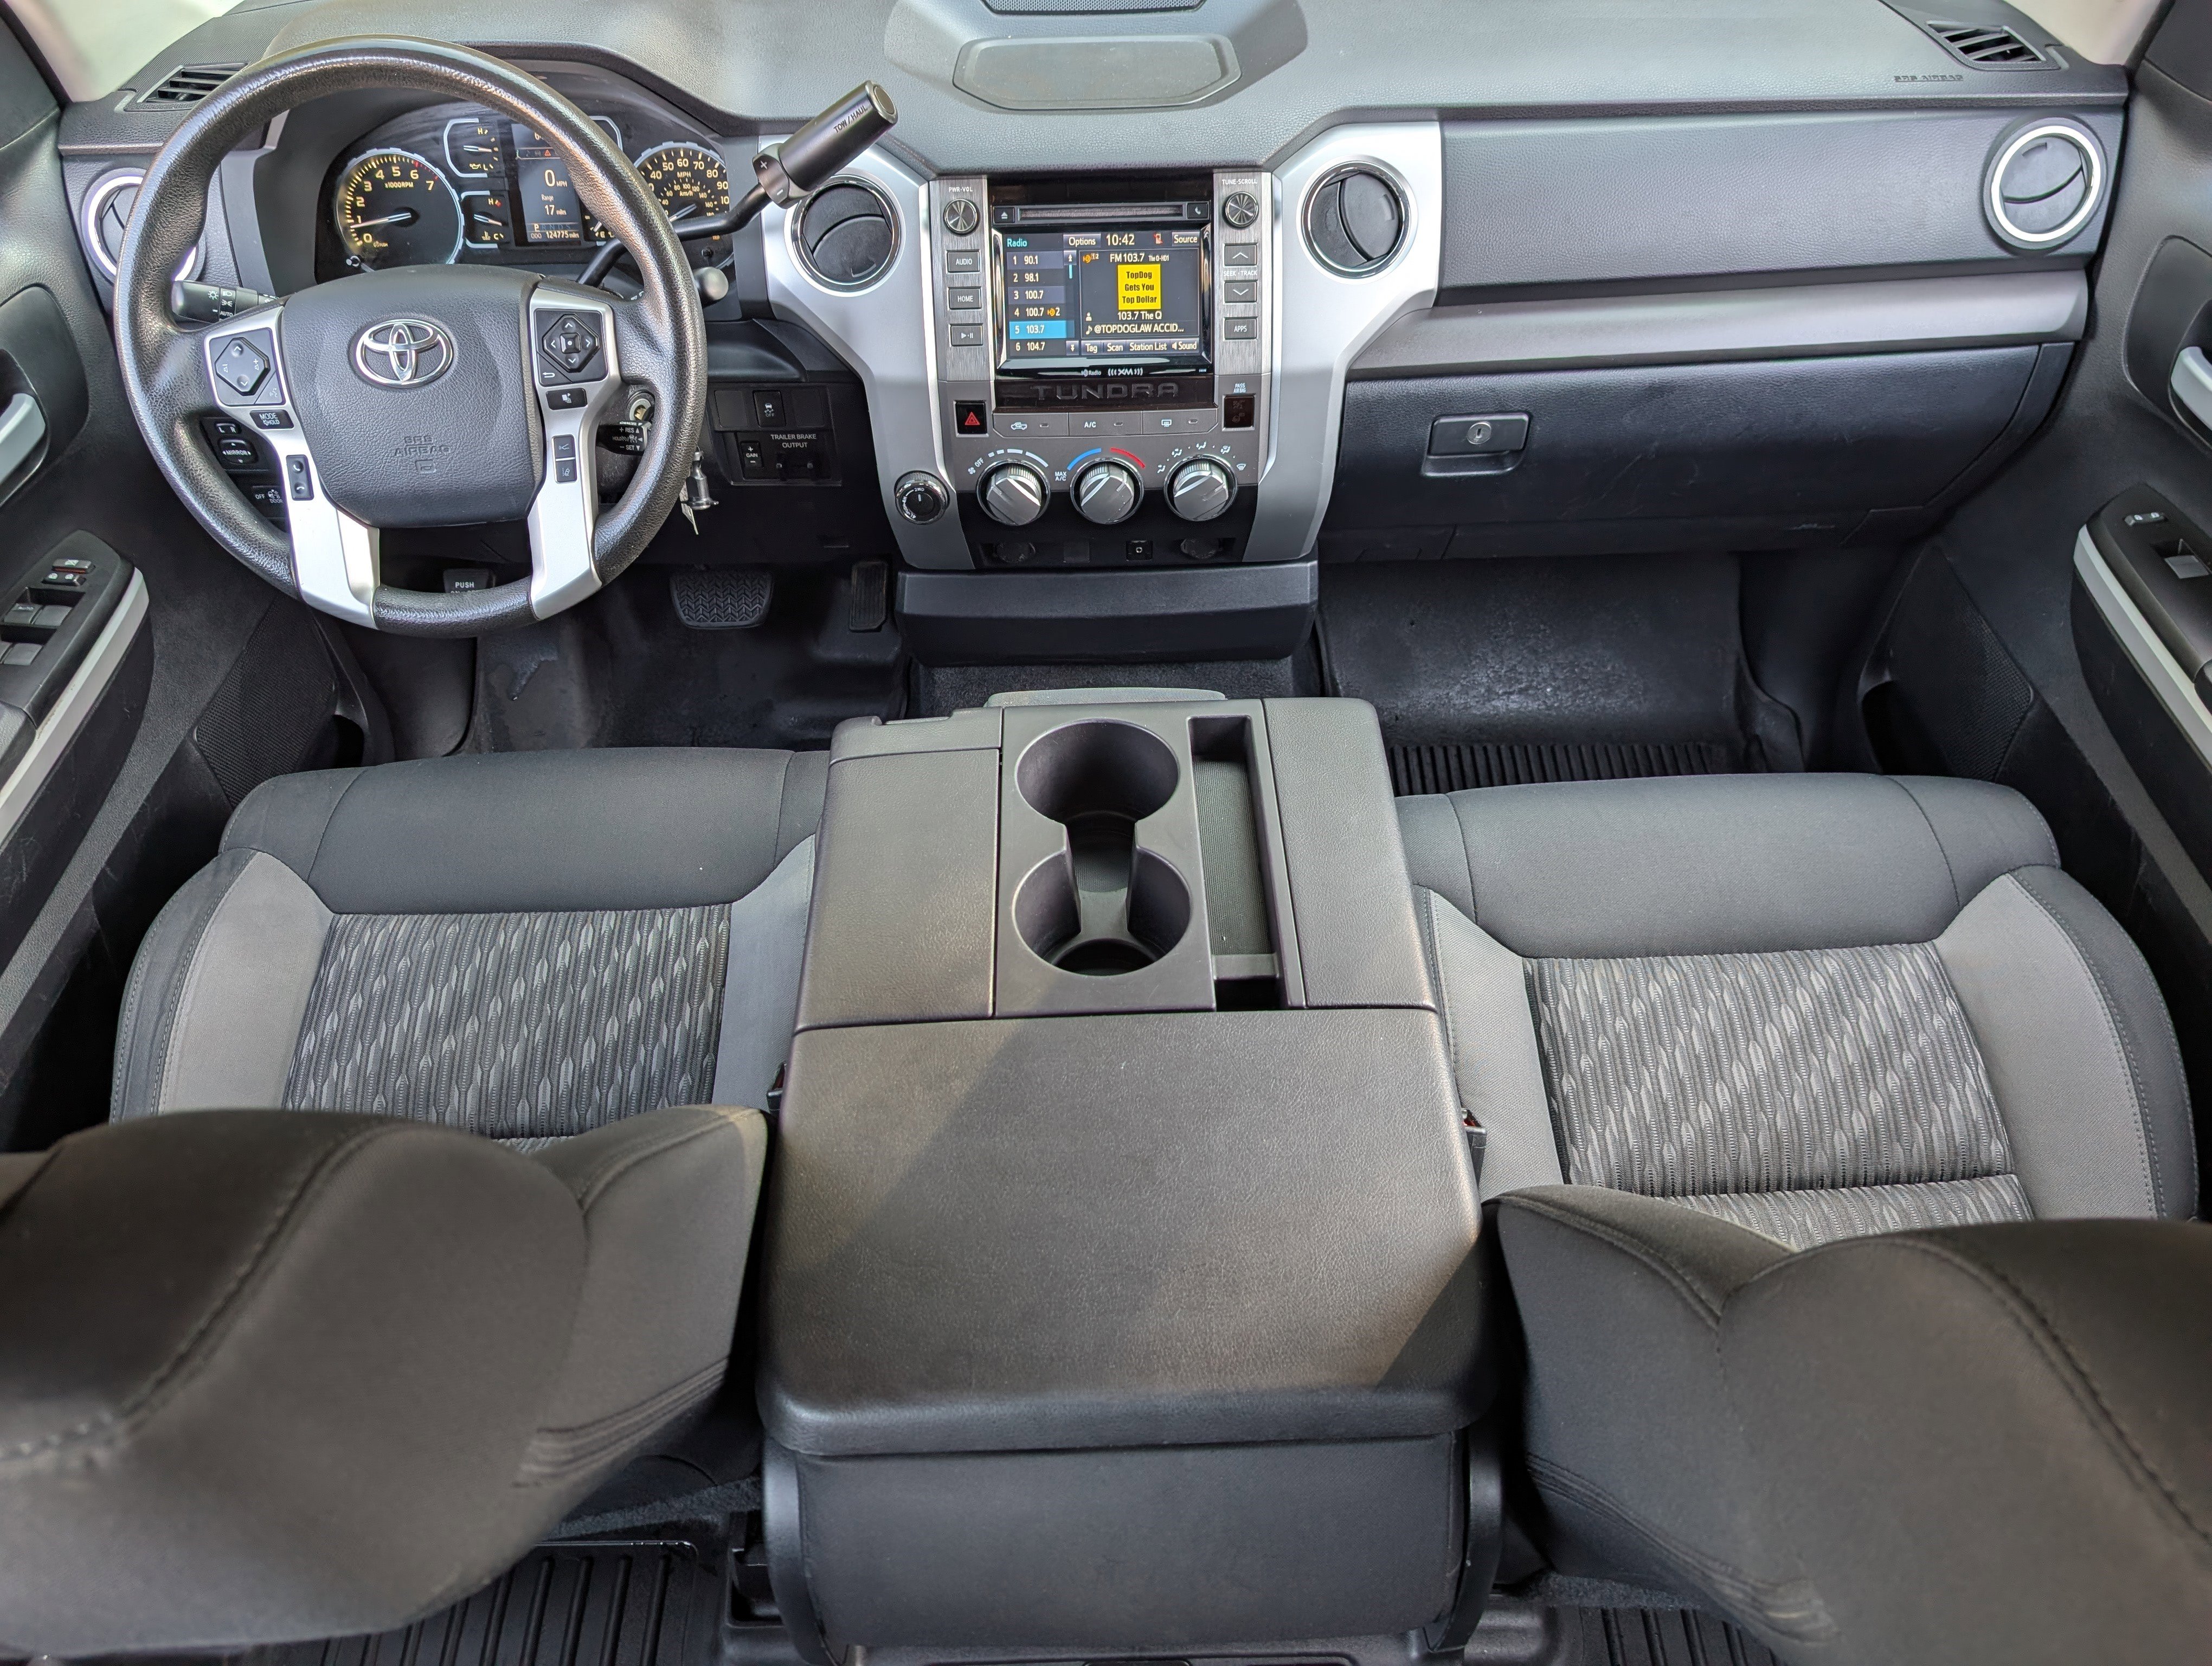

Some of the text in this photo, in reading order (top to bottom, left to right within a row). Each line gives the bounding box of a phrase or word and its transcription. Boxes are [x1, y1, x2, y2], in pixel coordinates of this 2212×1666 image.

[663, 162, 674, 171] 50
[677, 158, 689, 167] 60
[693, 161, 705, 170] 70
[375, 169, 384, 180] 4
[391, 166, 401, 177] 5
[410, 170, 419, 180] 6
[650, 171, 662, 180] 40
[706, 170, 718, 178] 80
[544, 169, 555, 187] 0
[364, 181, 372, 191] 3
[426, 180, 434, 190] 7
[717, 181, 729, 190] 90
[356, 196, 365, 207] 2
[545, 204, 555, 215] 17
[357, 215, 362, 224] 1
[363, 233, 372, 244] 0
[546, 230, 569, 239] 124775
[1007, 238, 1027, 247] Radio
[1069, 237, 1096, 247] Options
[1107, 233, 1135, 246] 10:42
[1174, 235, 1198, 244] Source
[1013, 255, 1038, 265] 1 90.1
[1013, 273, 1039, 283] 2 98.1
[1126, 271, 1152, 279] TopDog
[1013, 290, 1044, 299] 3 100.7
[1122, 296, 1135, 304] Top
[1014, 307, 1019, 317] 4
[1026, 307, 1044, 317] 100.7
[1118, 311, 1162, 321] 103.7 The Q
[1015, 324, 1045, 334] 5 103.7
[1094, 324, 1152, 334] @TOPDOGLAW
[1015, 342, 1045, 351] 6 104.7
[1085, 344, 1098, 353] Tag
[1107, 343, 1123, 351] Scan
[1129, 342, 1167, 351] Station List
[1178, 341, 1197, 350] Sound
[1031, 382, 1179, 400] TUNDRA
[975, 458, 984, 467] OFF
